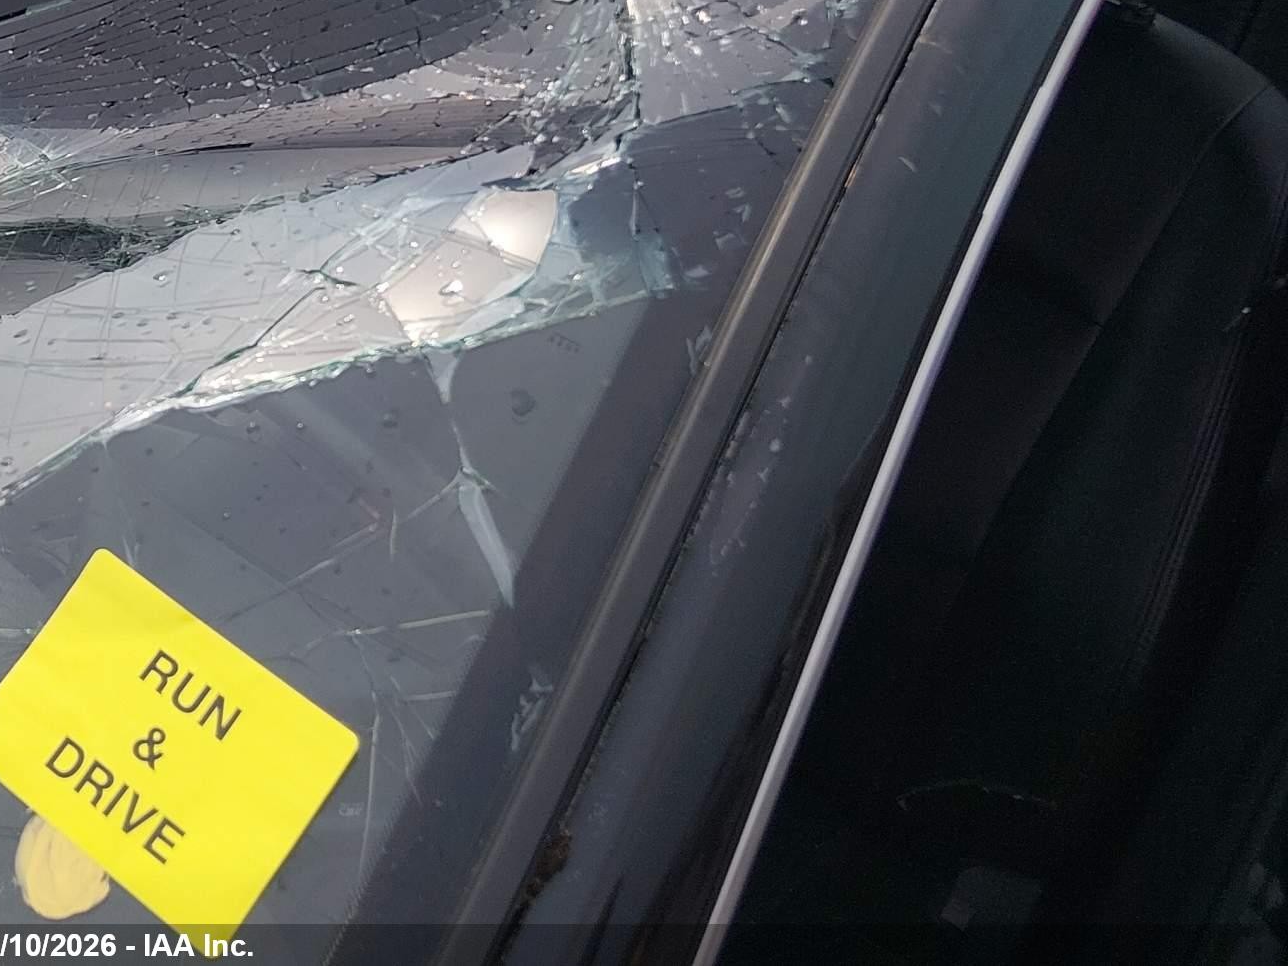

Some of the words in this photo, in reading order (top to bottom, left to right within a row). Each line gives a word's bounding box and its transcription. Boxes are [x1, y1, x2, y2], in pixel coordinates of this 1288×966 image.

[138, 649, 243, 742] RUN
[132, 727, 167, 771] &
[44, 735, 187, 865] DRIVE
